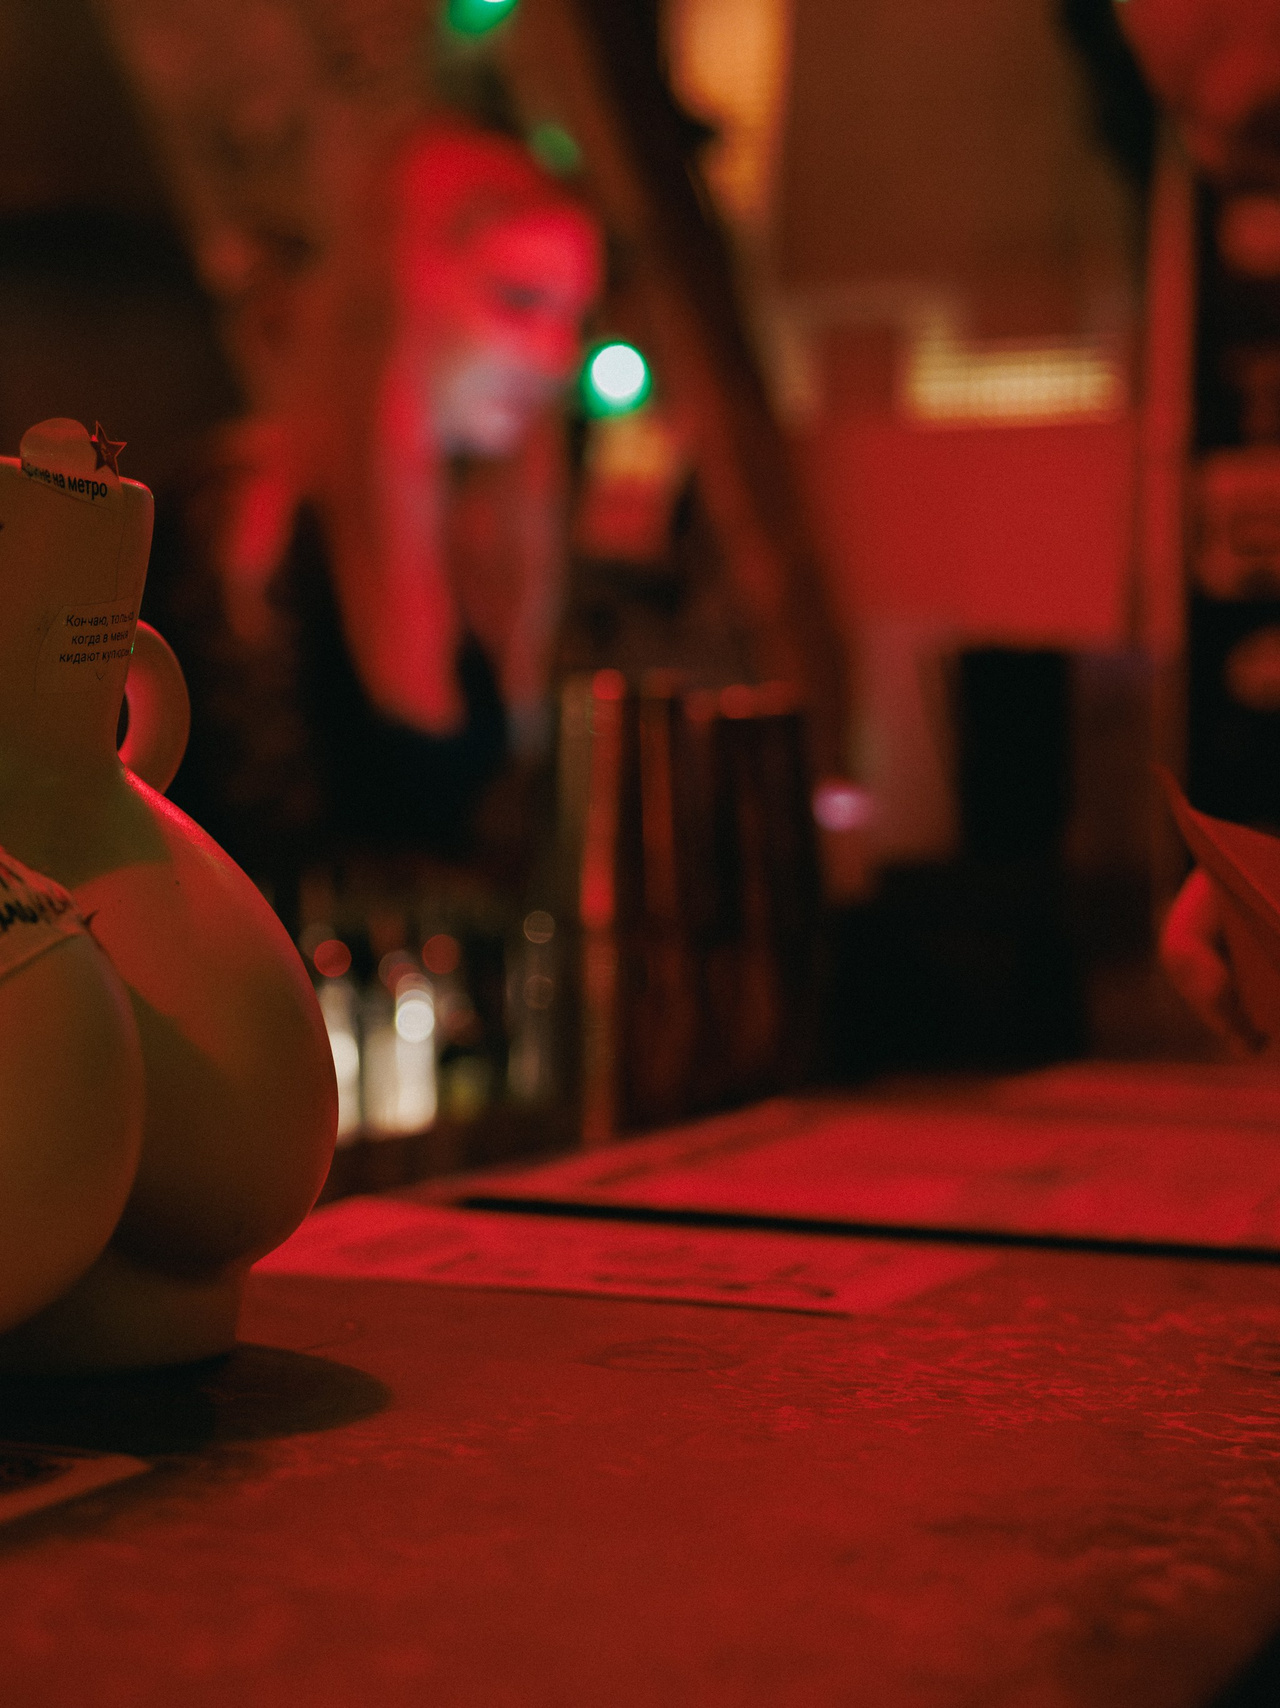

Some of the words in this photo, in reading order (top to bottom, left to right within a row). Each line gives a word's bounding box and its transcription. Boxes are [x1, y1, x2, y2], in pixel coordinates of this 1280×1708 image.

[68, 476, 108, 500] метро
[66, 614, 109, 627] Кончаю,
[71, 634, 100, 646] когда
[102, 633, 109, 644] в
[59, 652, 100, 664] кидают
